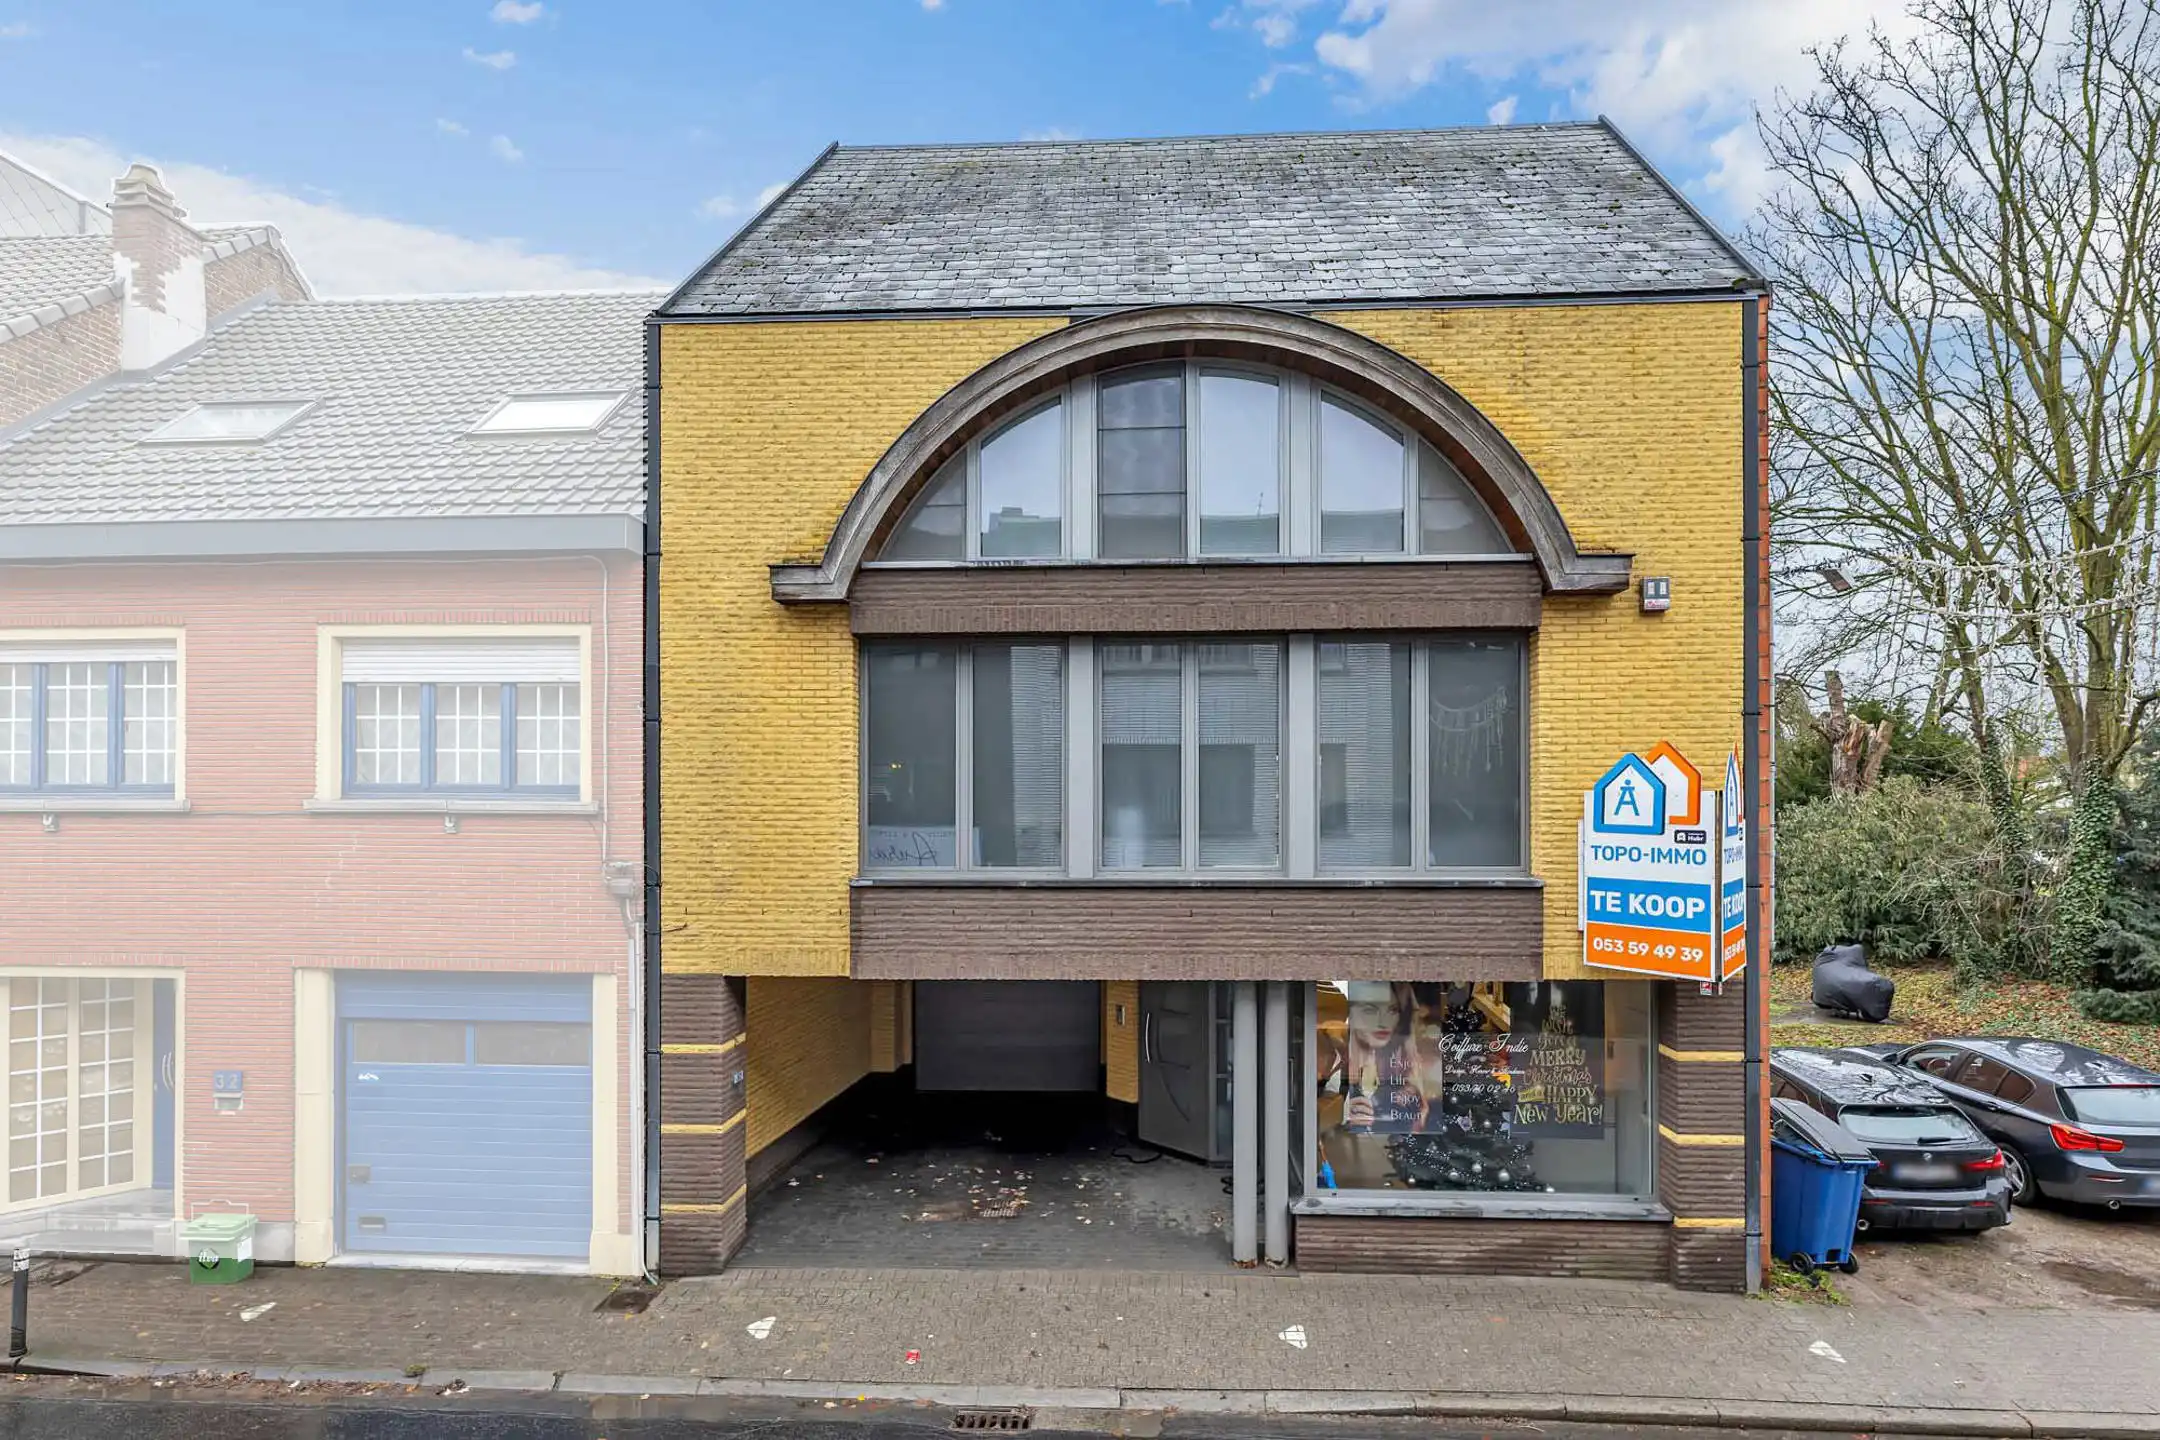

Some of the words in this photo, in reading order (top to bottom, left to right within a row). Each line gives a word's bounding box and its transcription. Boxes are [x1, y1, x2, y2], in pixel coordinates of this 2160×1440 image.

[1591, 844, 1707, 865] TOPO-IMMO
[1589, 889, 1622, 913] TE
[1628, 893, 1705, 919] KOOP
[1593, 937, 1625, 953] 053
[1628, 941, 1649, 956] 59
[1653, 944, 1676, 959] 49
[1680, 946, 1704, 963] 39
[215, 1073, 238, 1090] 32
